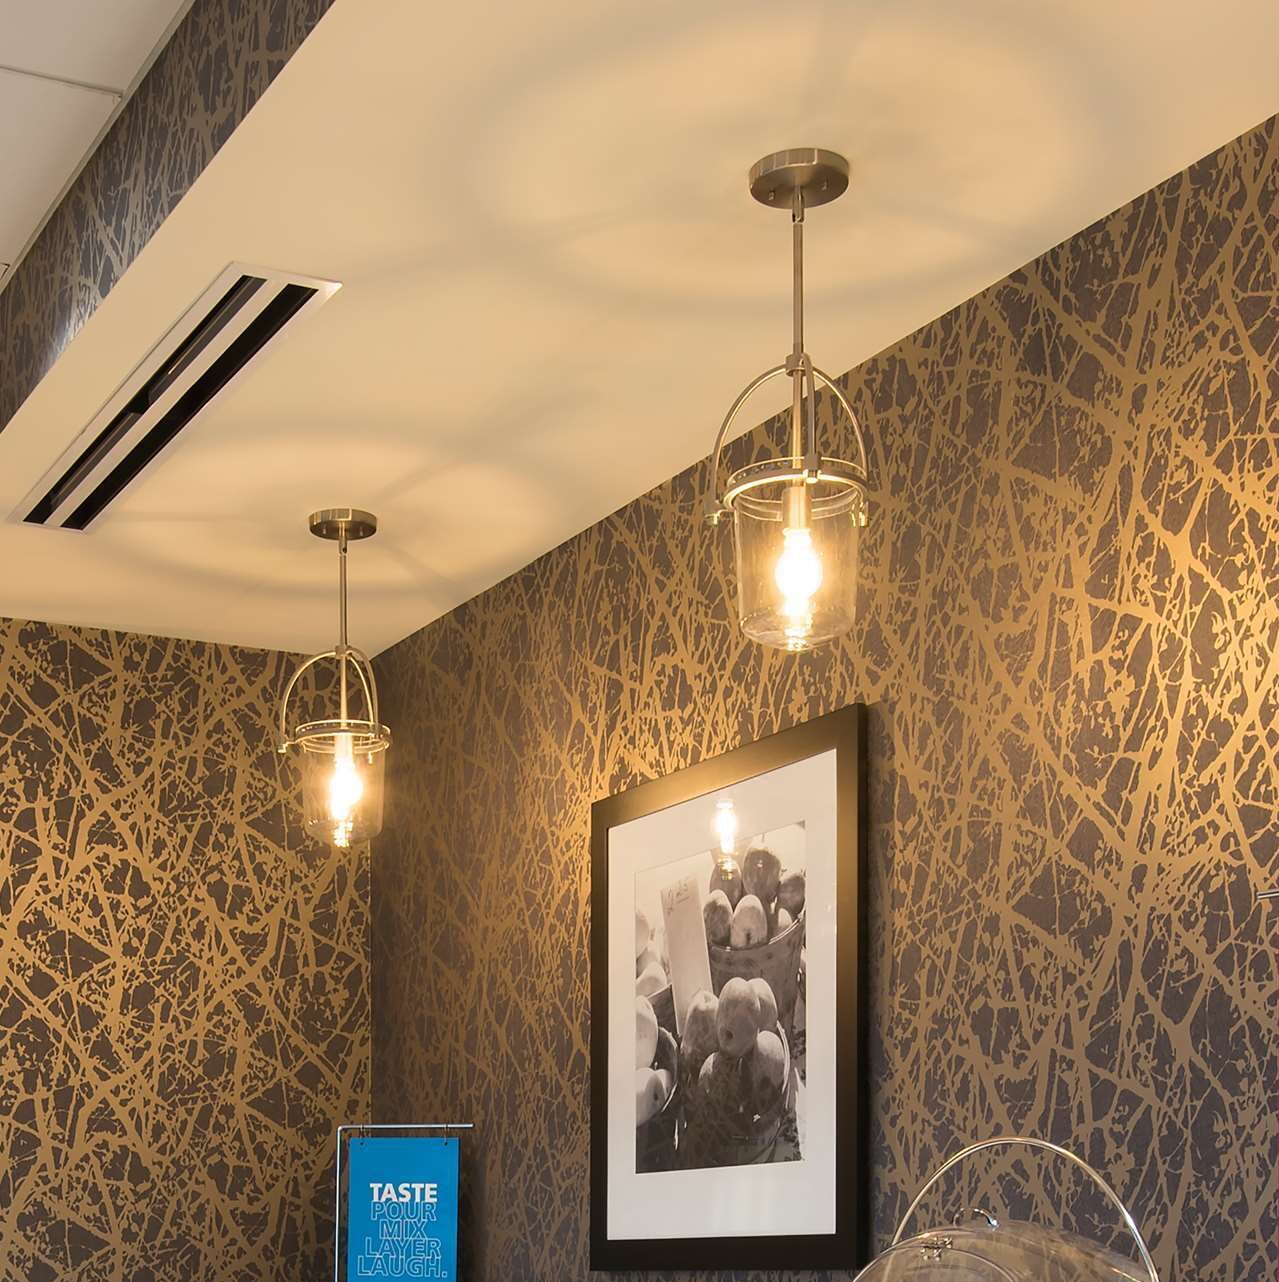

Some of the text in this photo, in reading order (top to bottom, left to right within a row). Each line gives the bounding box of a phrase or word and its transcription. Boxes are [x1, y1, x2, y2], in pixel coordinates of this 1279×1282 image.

[370, 1183, 438, 1203] TASTE
[370, 1200, 437, 1222] POUR
[379, 1219, 428, 1240] MIX
[365, 1236, 442, 1259] LAYER
[357, 1255, 448, 1279] LAUGH.
